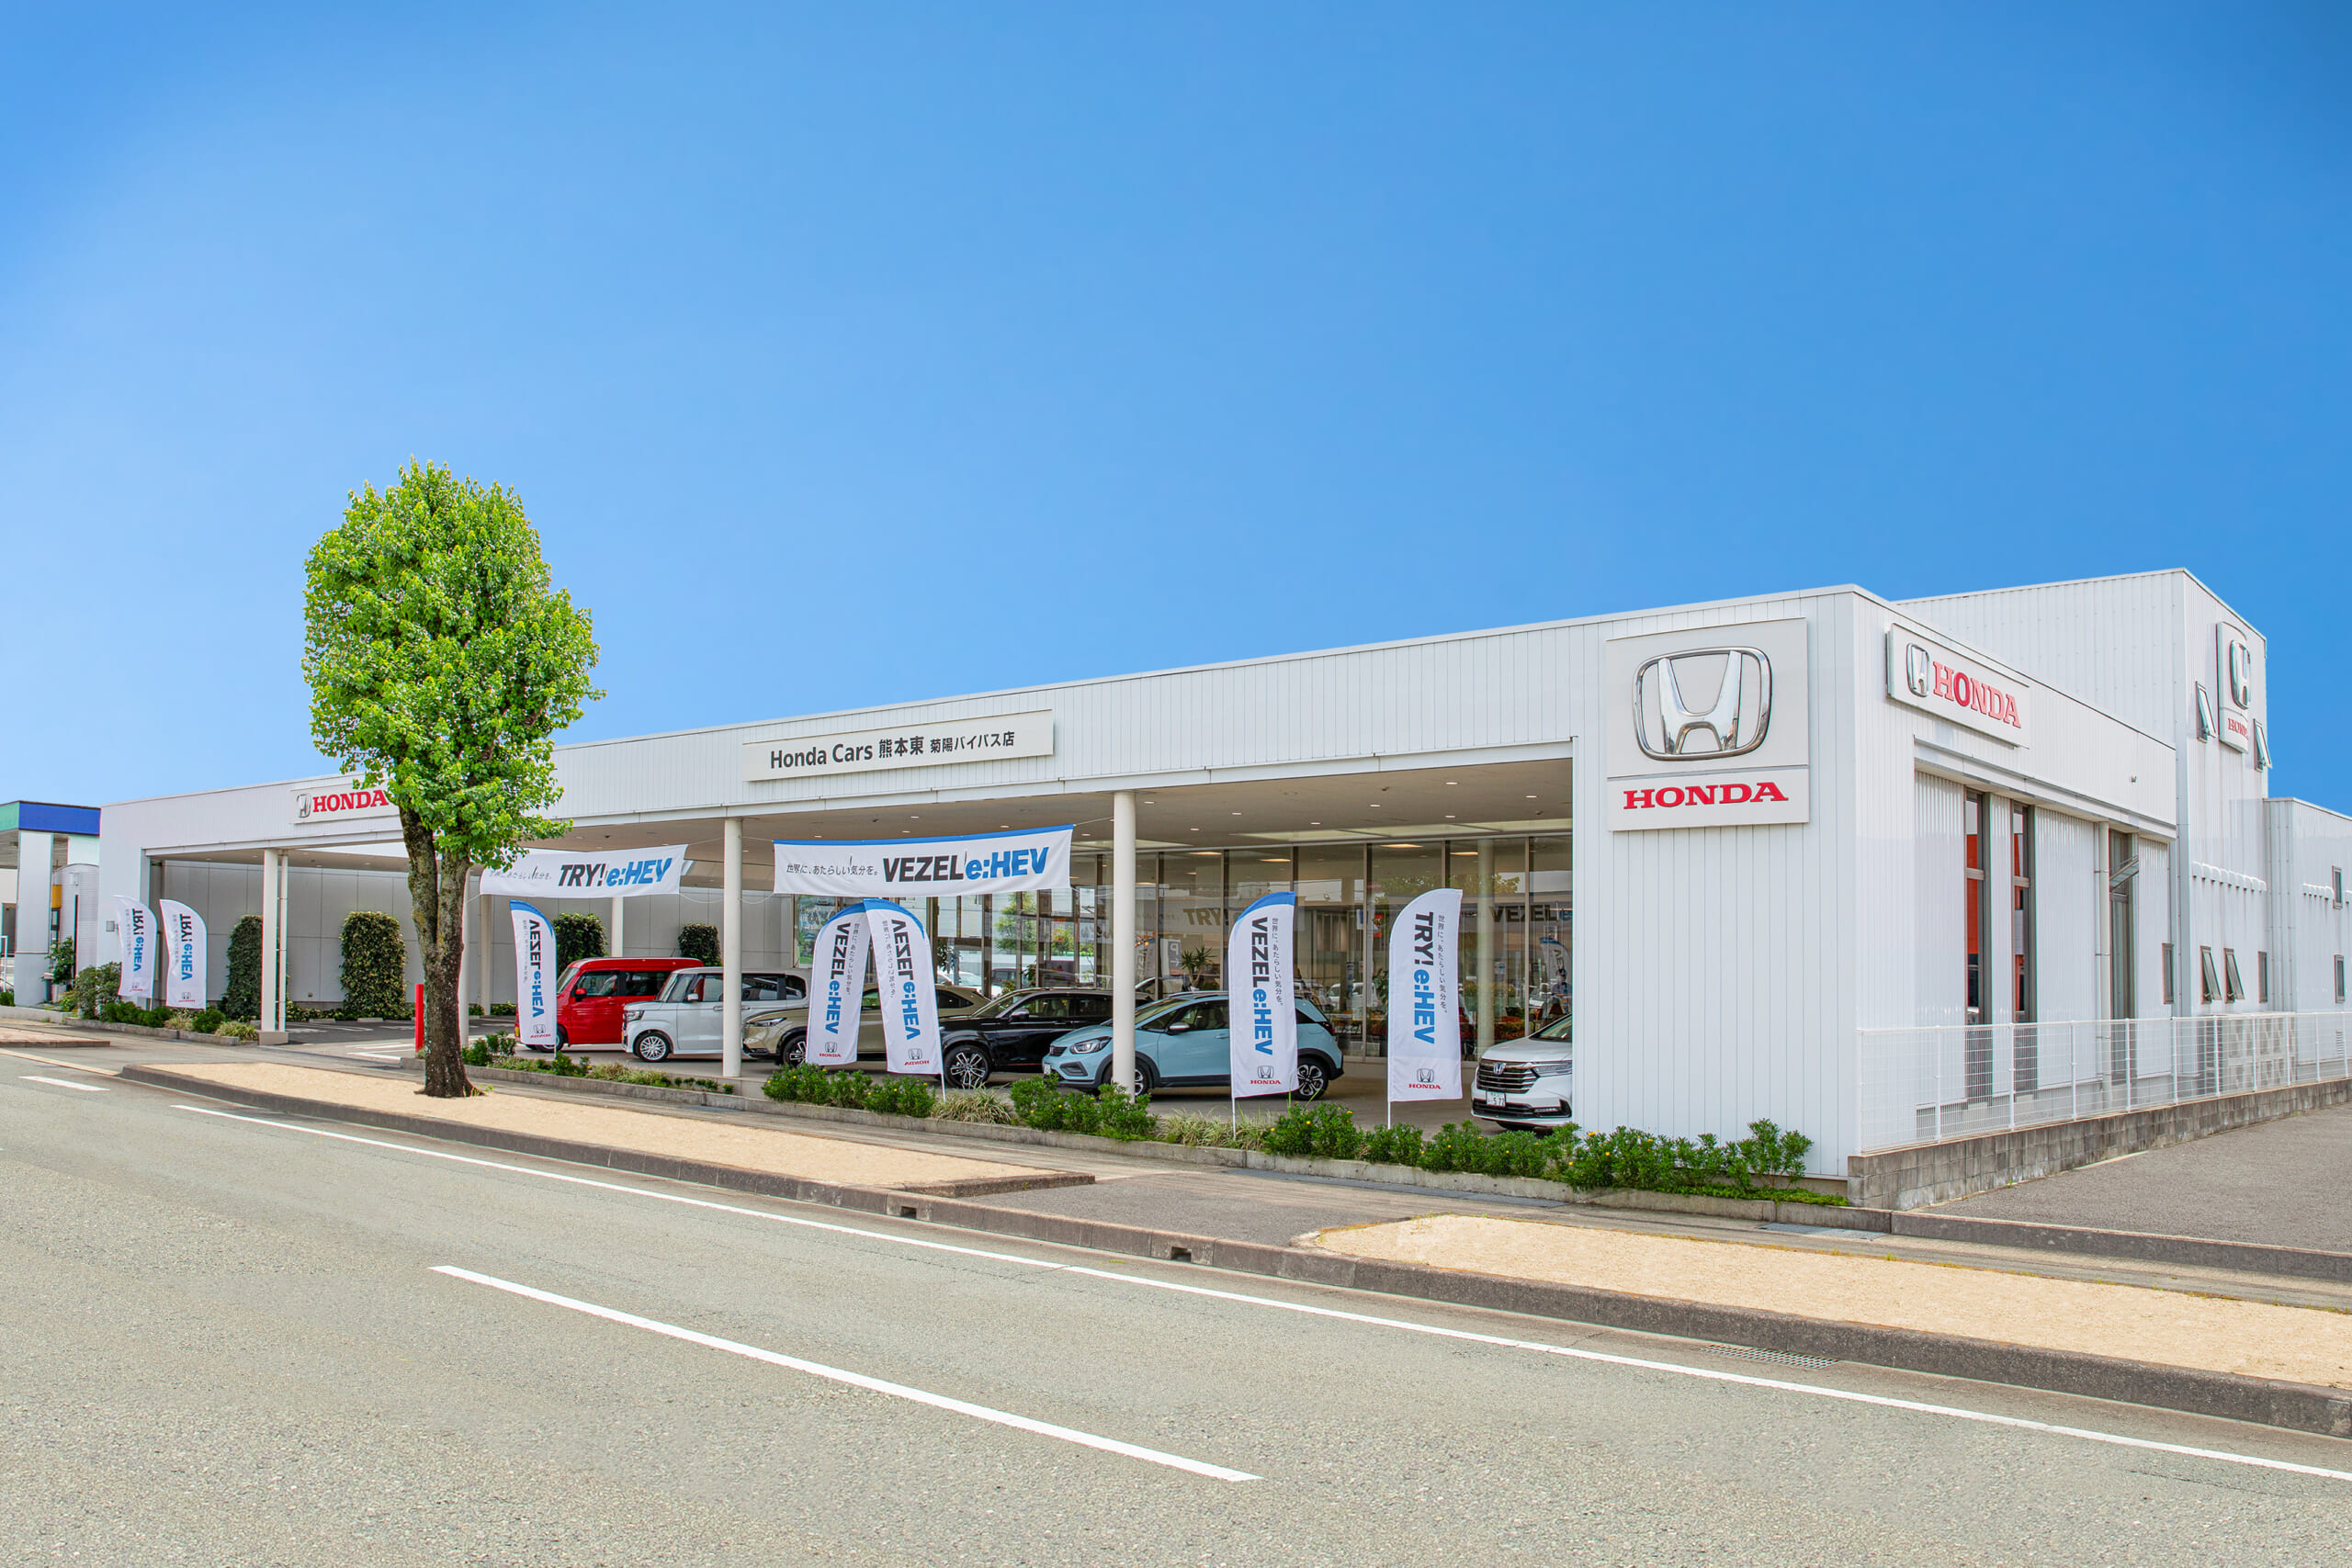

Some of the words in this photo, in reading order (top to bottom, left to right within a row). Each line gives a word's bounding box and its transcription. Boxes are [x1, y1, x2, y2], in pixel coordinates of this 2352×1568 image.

[1932, 660, 2022, 729] HONDA
[770, 746, 827, 769] Honda
[831, 743, 873, 763] Cars
[878, 736, 924, 759] 熊本東
[312, 789, 389, 813] HONDA
[1623, 782, 1789, 810] HONDA
[558, 863, 606, 887] TRY!
[606, 857, 673, 886] e:HEV
[882, 854, 965, 883] VEZEL
[965, 846, 1050, 880] e:HEV
[830, 921, 852, 980] VEZEL
[1251, 916, 1271, 987] VEZEL
[1414, 911, 1434, 966] TRY!
[825, 980, 842, 1034] e:HEV
[1252, 988, 1273, 1056] e:HEV
[1413, 968, 1435, 1044] e:HEV
